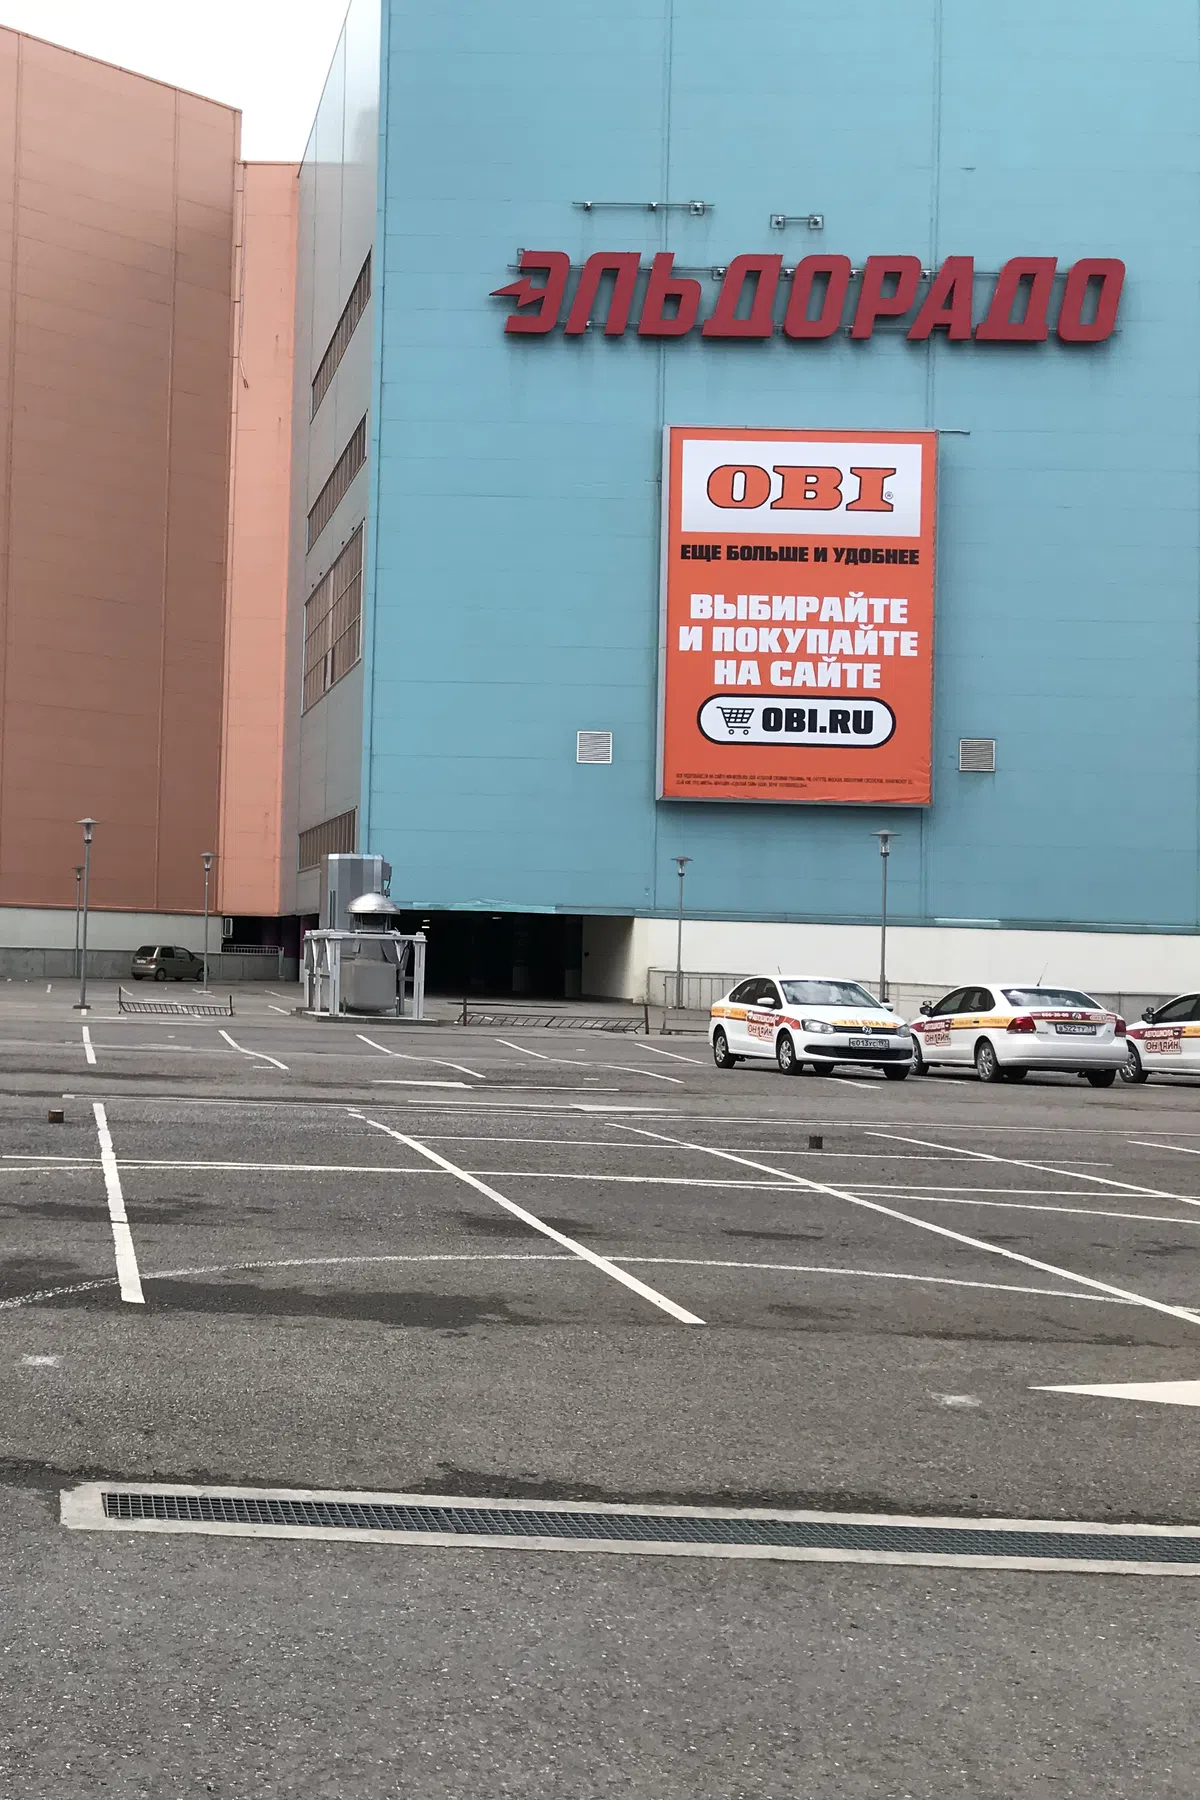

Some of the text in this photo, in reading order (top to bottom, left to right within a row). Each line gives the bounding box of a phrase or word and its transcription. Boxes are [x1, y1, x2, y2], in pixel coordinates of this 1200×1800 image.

[488, 250, 1126, 343] ЭЛЬДОРАДО
[706, 464, 897, 512] OBI
[680, 544, 919, 565] ЕЩЕ БОЛЬШЕ И УДОБНЕЕ
[690, 591, 908, 624] ВЫБИРАЙТЕ
[679, 624, 918, 656] И ПОКУПАЙТЕ
[714, 656, 881, 688] НА САЙТЕ
[762, 707, 874, 734] OBI.RU
